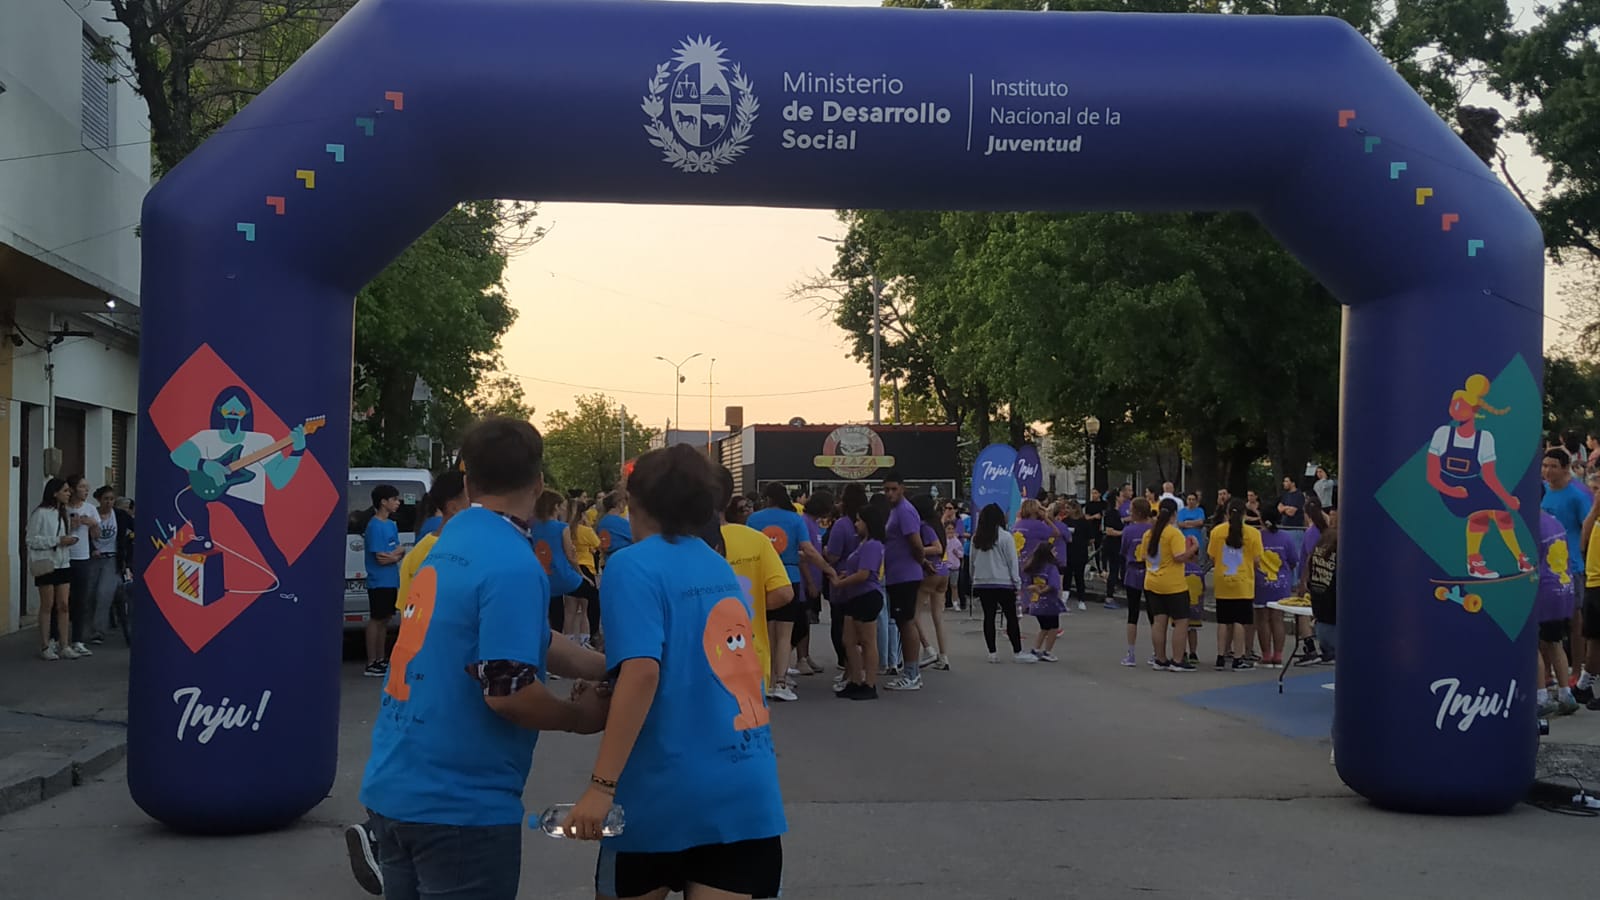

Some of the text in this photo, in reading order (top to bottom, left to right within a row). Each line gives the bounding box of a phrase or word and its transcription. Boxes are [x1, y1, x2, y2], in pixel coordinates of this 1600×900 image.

[784, 72, 904, 95] Ministerio
[991, 79, 1069, 97] Instituto
[783, 101, 951, 124] de Desarrollo
[991, 107, 1121, 125] Nacional de la
[782, 129, 856, 150] Social
[985, 135, 1082, 155] Juventud
[831, 457, 877, 466] PLAZA
[981, 460, 1015, 481] Inju!
[1018, 458, 1039, 480] Inju!
[173, 686, 272, 744] Inju!
[1430, 677, 1517, 732] Inju!
